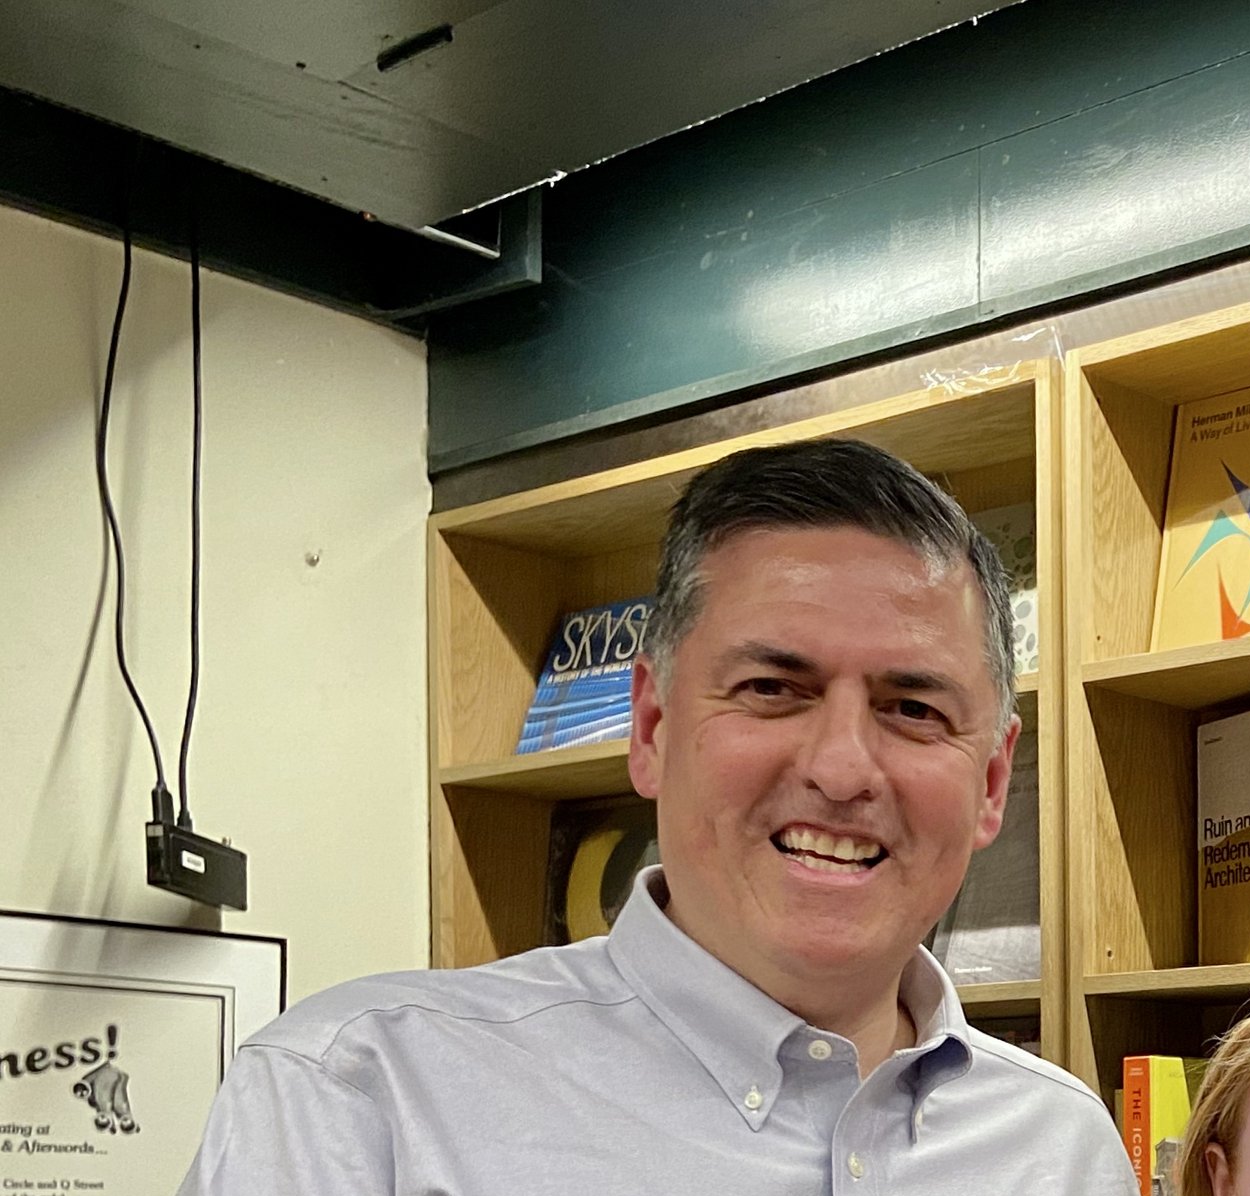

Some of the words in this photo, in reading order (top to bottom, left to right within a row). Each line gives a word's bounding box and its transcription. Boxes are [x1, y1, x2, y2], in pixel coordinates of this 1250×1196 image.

[1191, 411, 1233, 429] Herman
[1190, 430, 1198, 442] A
[1200, 427, 1221, 441] Way
[1223, 421, 1234, 435] of
[553, 604, 653, 672] SKYS
[1204, 815, 1232, 841] Ruin
[1132, 1088, 1142, 1120] THE
[1, 1139, 13, 1153] &
[3, 1178, 33, 1190] Circle
[37, 1179, 57, 1190] and
[60, 1179, 70, 1191] Q
[74, 1178, 104, 1190] Street
